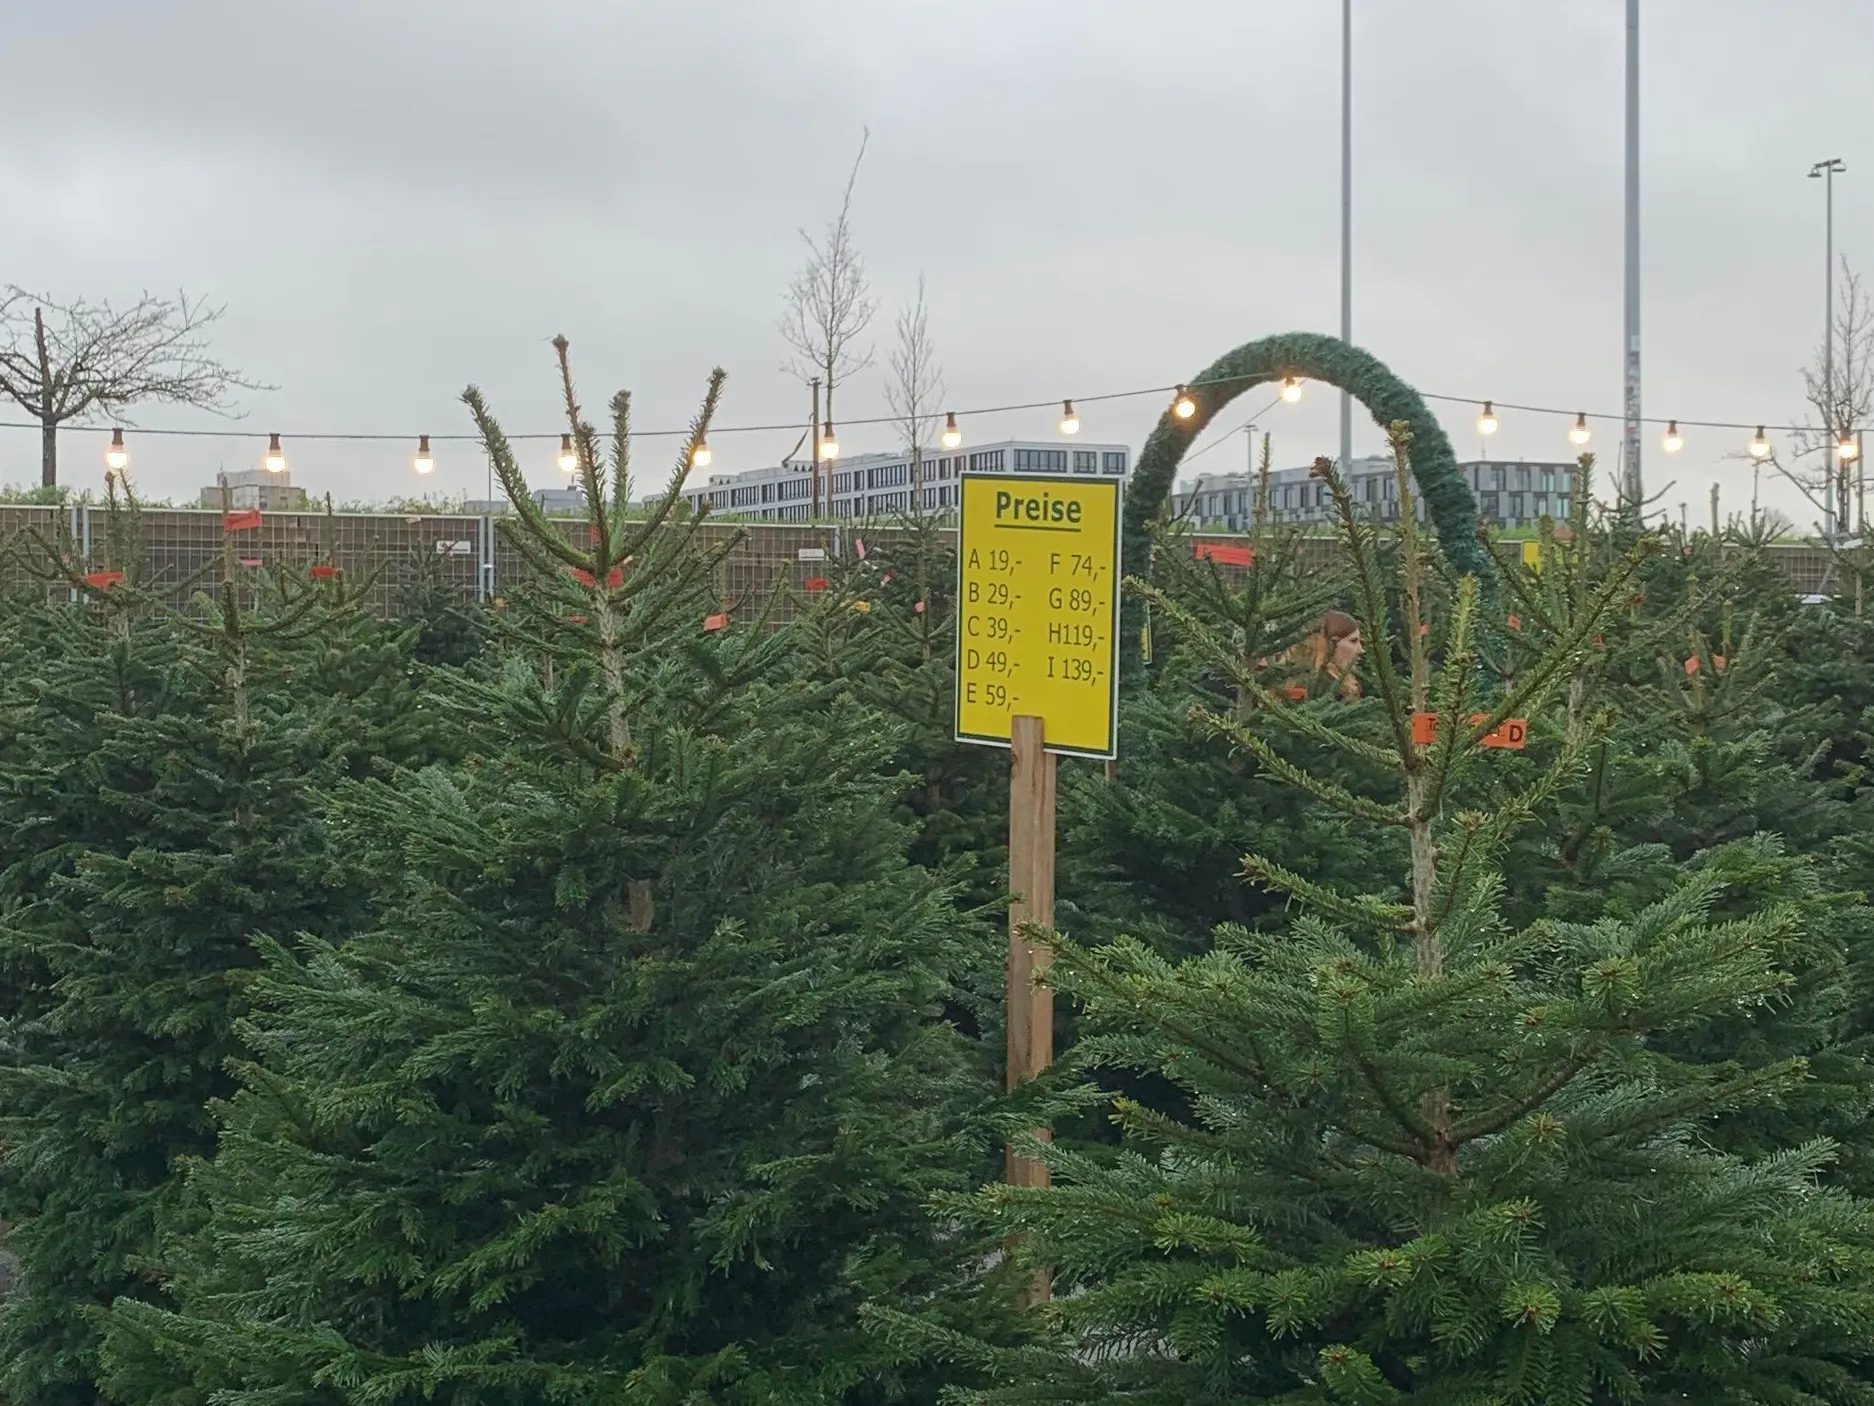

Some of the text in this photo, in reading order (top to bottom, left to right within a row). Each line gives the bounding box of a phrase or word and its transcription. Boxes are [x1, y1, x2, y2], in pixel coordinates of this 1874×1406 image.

[996, 491, 1082, 523] Preise
[968, 548, 1022, 576] A 19,-
[1050, 553, 1106, 582] F 74,-
[968, 582, 1022, 610] B 29,-
[1049, 588, 1106, 616] G 89,-
[967, 615, 1021, 644] C 39,-
[967, 648, 1020, 678] D 49,-
[1047, 656, 1104, 687] I 139,-
[966, 682, 1019, 712] E 59,-
[1509, 724, 1523, 742] D
